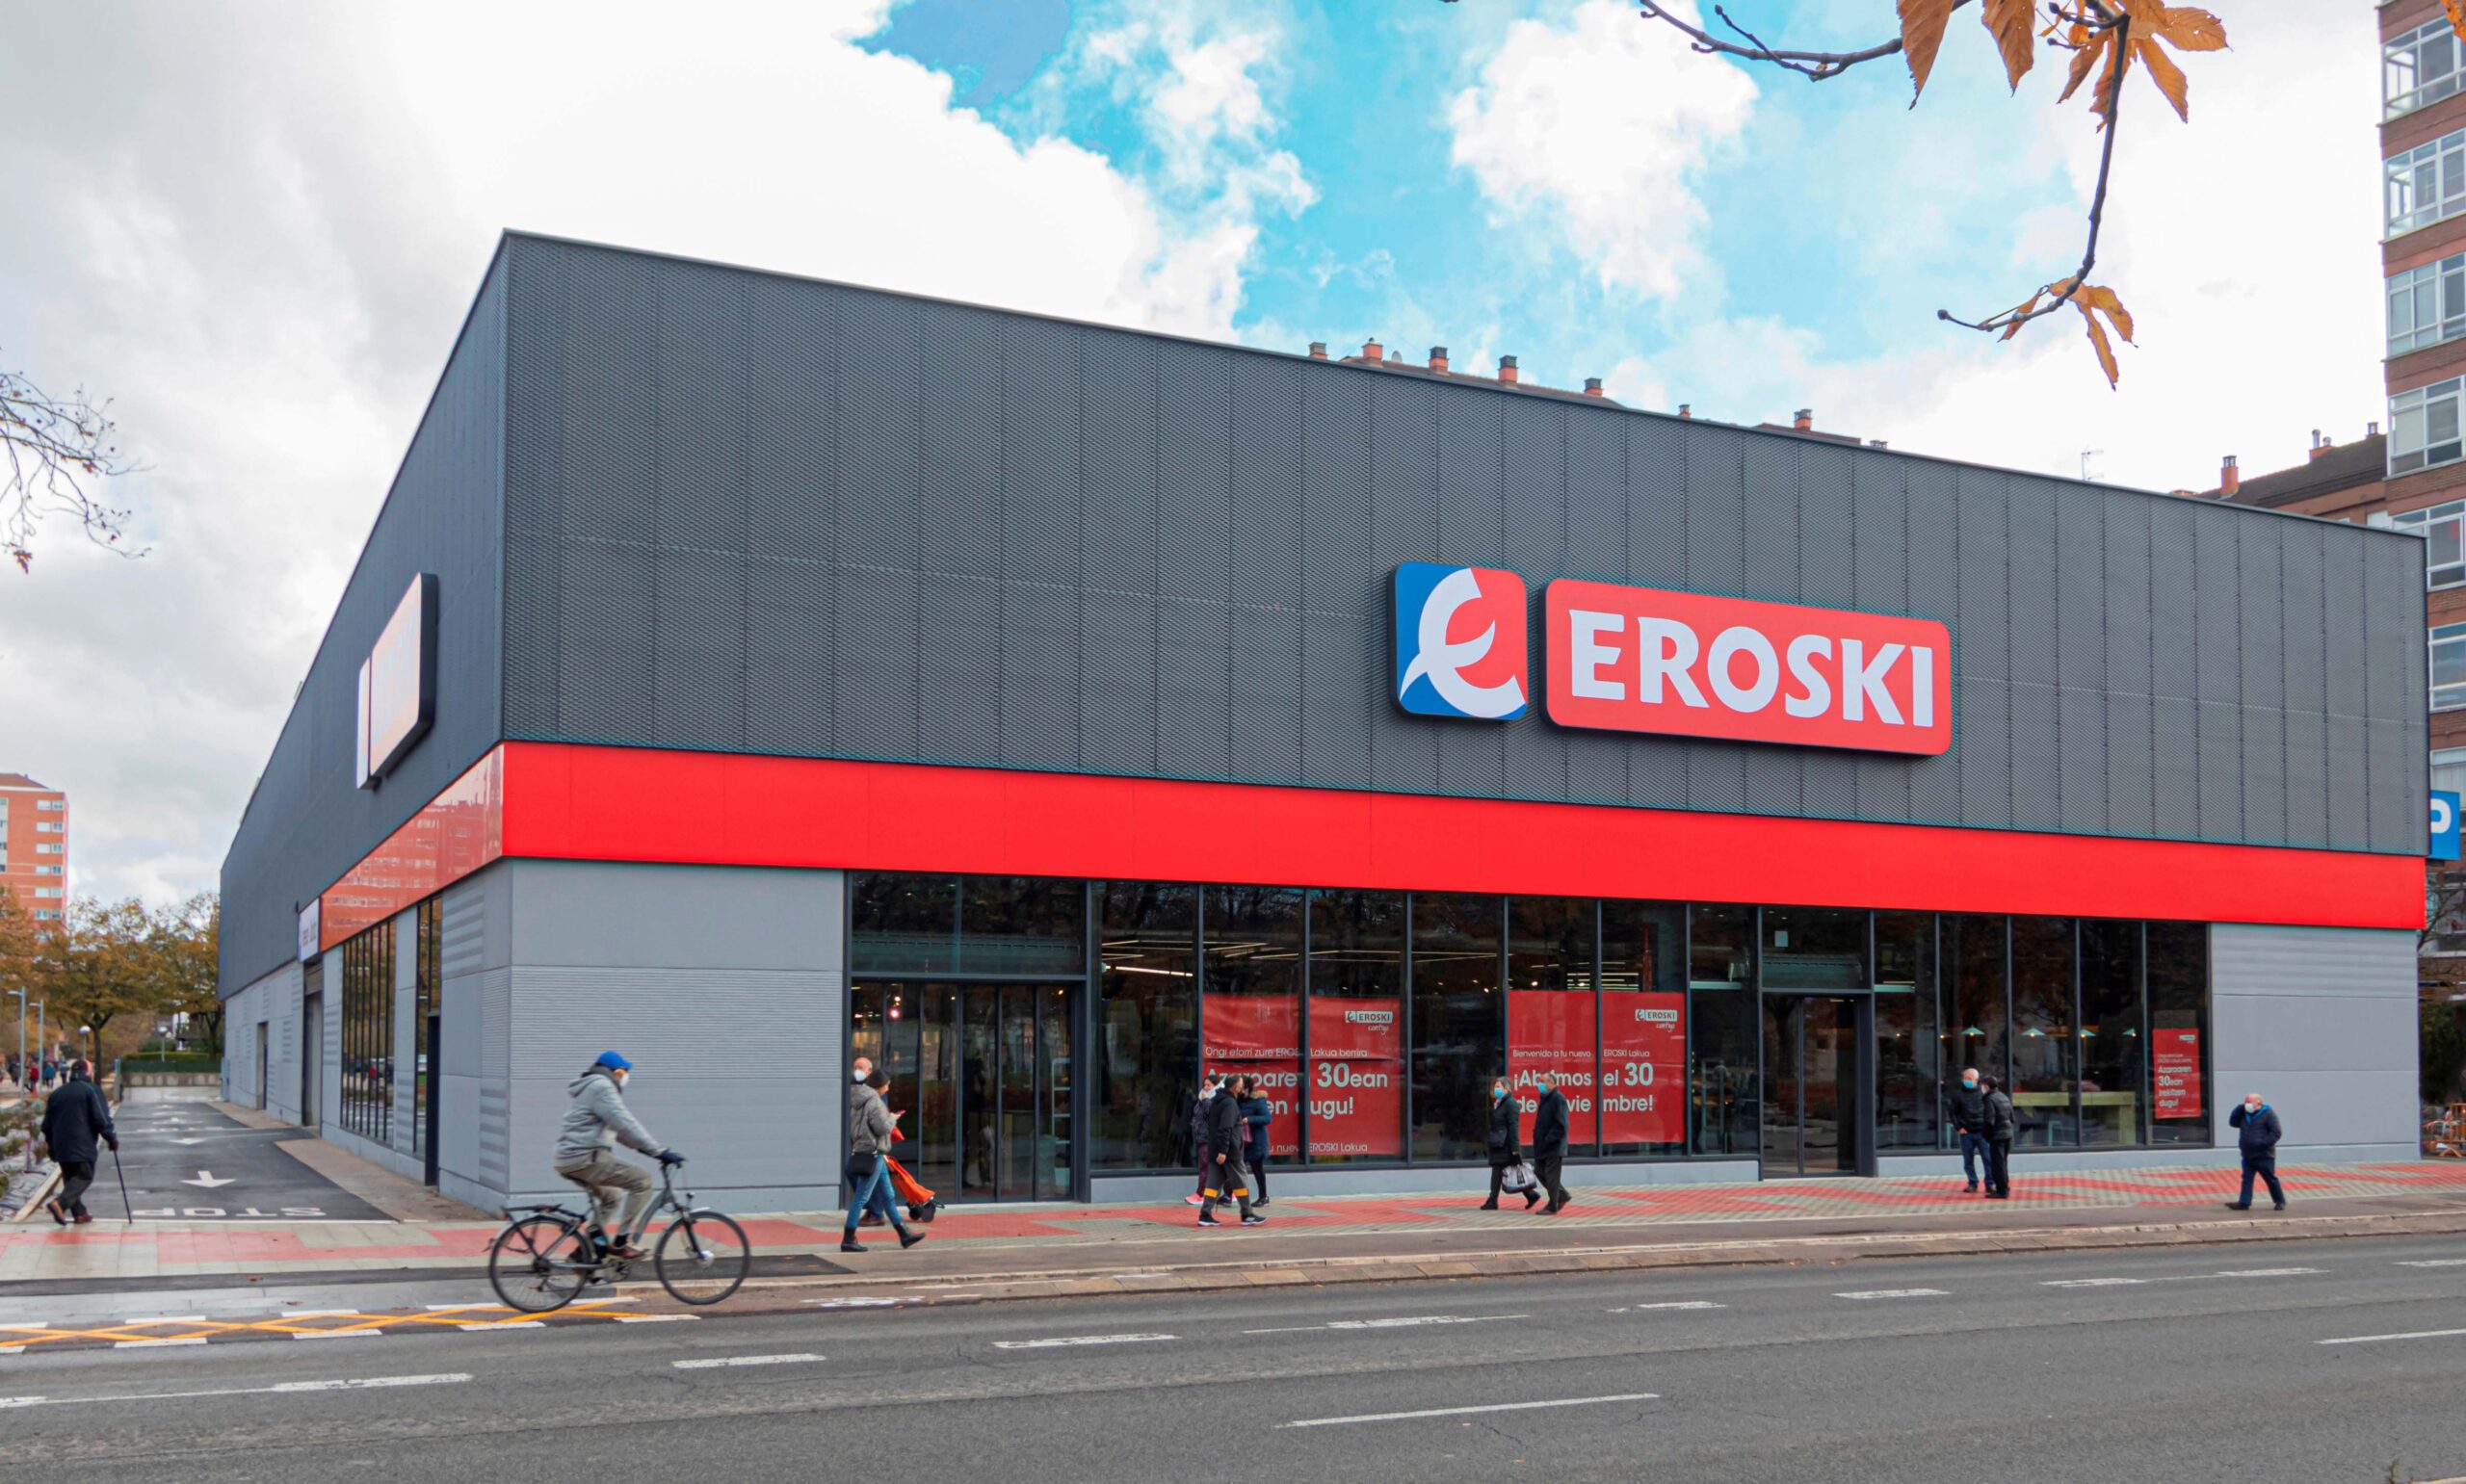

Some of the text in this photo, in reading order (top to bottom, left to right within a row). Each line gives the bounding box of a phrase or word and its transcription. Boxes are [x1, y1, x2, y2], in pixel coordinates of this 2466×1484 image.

[1568, 608, 1933, 728] EROSKI
[1205, 1047, 1227, 1058] Ongi
[1310, 1048, 1337, 1056] Lakua
[1318, 1062, 1388, 1088] 30ean
[1603, 1069, 1618, 1086] el
[1624, 1062, 1654, 1086] 30
[1340, 1143, 1368, 1152] Lakua
[132, 1208, 327, 1216] STOP
